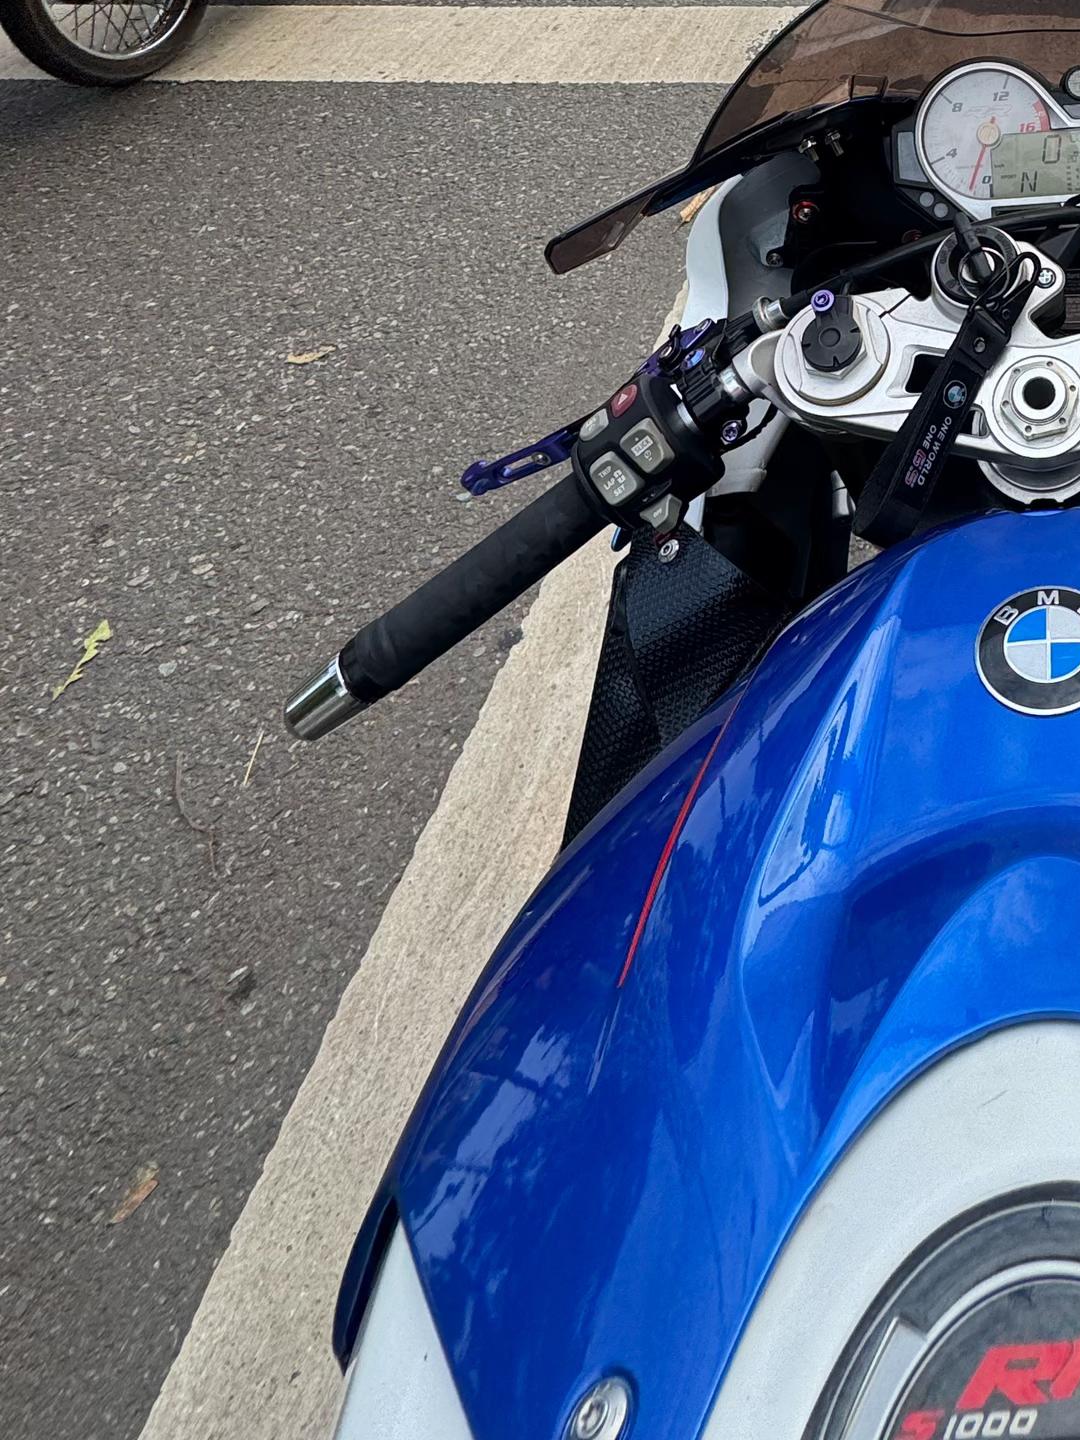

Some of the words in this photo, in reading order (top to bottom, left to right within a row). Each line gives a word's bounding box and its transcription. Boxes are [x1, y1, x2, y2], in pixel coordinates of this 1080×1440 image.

[992, 91, 1009, 102] 12
[951, 102, 963, 113] 8
[1018, 122, 1036, 133] 16
[945, 148, 958, 159] 4
[1041, 134, 1062, 165] 0
[981, 175, 992, 185] 0
[1020, 170, 1038, 193] N
[937, 417, 952, 441] ONE
[922, 425, 937, 449] ONE
[917, 441, 941, 486] WORLD
[603, 477, 616, 491] LAP
[613, 484, 626, 498] SET
[943, 1408, 1038, 1440] 1000
